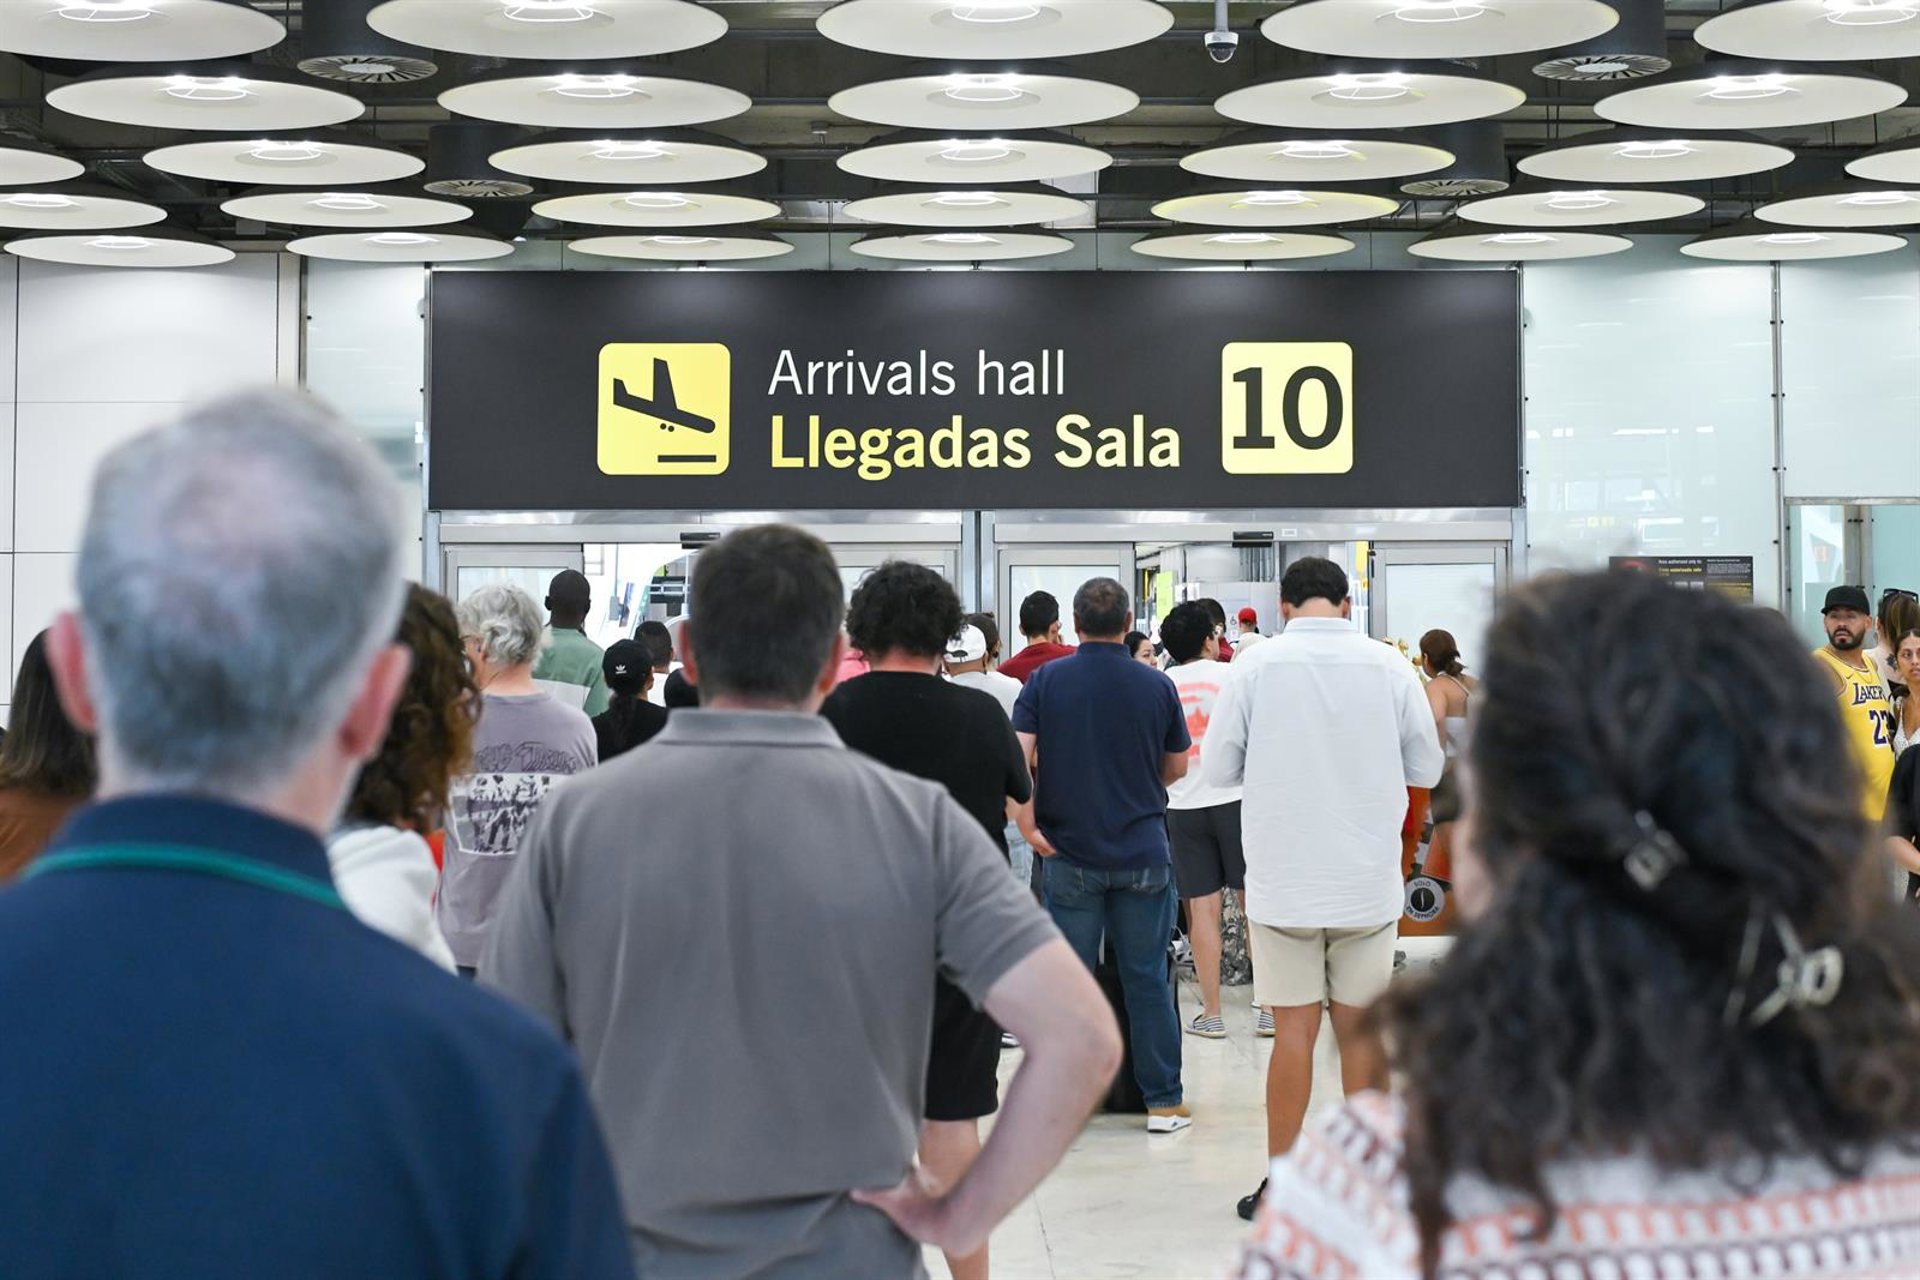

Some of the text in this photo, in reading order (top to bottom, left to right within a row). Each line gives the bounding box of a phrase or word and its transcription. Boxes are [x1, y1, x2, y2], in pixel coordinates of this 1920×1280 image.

[768, 349, 1064, 396] Arrivals hall
[1233, 365, 1344, 450] 10
[771, 413, 1181, 481] Llegadas Sala
[1852, 683, 1886, 705] LAKER
